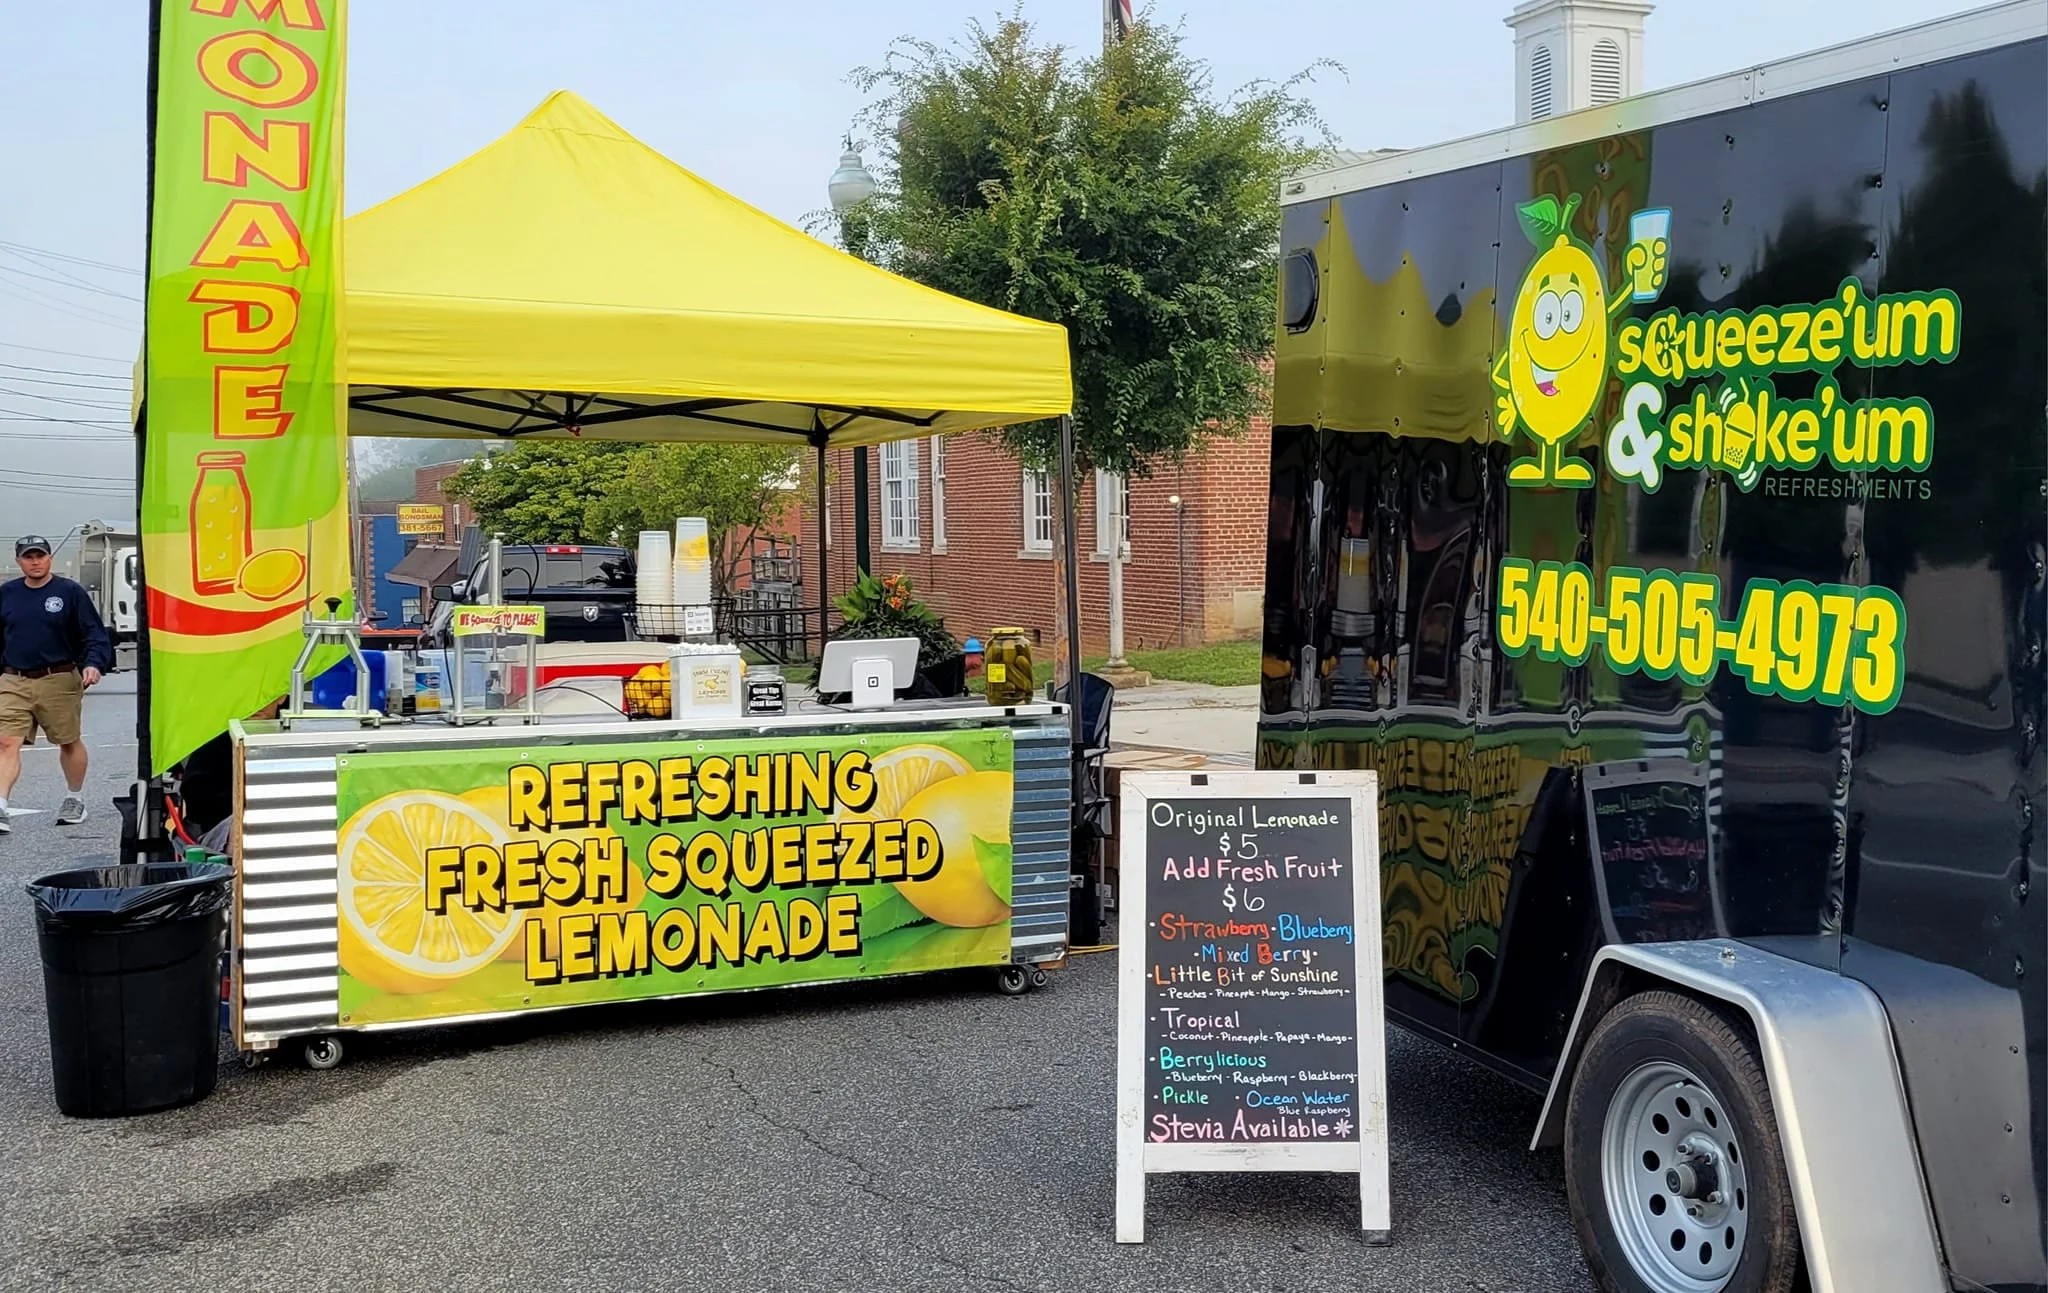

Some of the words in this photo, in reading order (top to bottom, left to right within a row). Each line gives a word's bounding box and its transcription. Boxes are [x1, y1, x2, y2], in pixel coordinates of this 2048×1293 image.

[1607, 381, 1663, 488] &
[1763, 477, 1932, 500] REFRESHMENTS
[459, 613, 470, 626] WE
[503, 613, 512, 625] TO
[1500, 565, 1900, 704] 540-505-4973
[508, 750, 878, 834] REFRESHING
[1151, 802, 1244, 835] Original
[1252, 804, 1339, 829] Lemonade
[1219, 831, 1258, 859] $5
[425, 835, 630, 915] FRESH
[646, 819, 943, 900] SQUEEZED
[1163, 856, 1210, 881] Add
[1217, 858, 1279, 883] Fresh
[1285, 855, 1343, 879] Fruit
[1222, 883, 1265, 912] $6
[525, 894, 864, 985] LEMONADE
[1160, 912, 1270, 941] Strawberry
[1278, 913, 1354, 944] Blueberry
[1202, 943, 1249, 963] Mixed
[1256, 942, 1312, 965] Berry
[1154, 965, 1213, 985] Little
[1217, 967, 1245, 986] Bit
[1251, 969, 1266, 982] of
[1270, 967, 1339, 983] Sunshine
[1160, 1007, 1241, 1030] Tropical
[1159, 1046, 1267, 1072] Berrylicious
[1162, 1086, 1209, 1104] Pickle
[1246, 1090, 1297, 1107] Ocean
[1302, 1091, 1350, 1105] Water
[1278, 1106, 1300, 1115] Blue
[1150, 1113, 1224, 1142] Stevia
